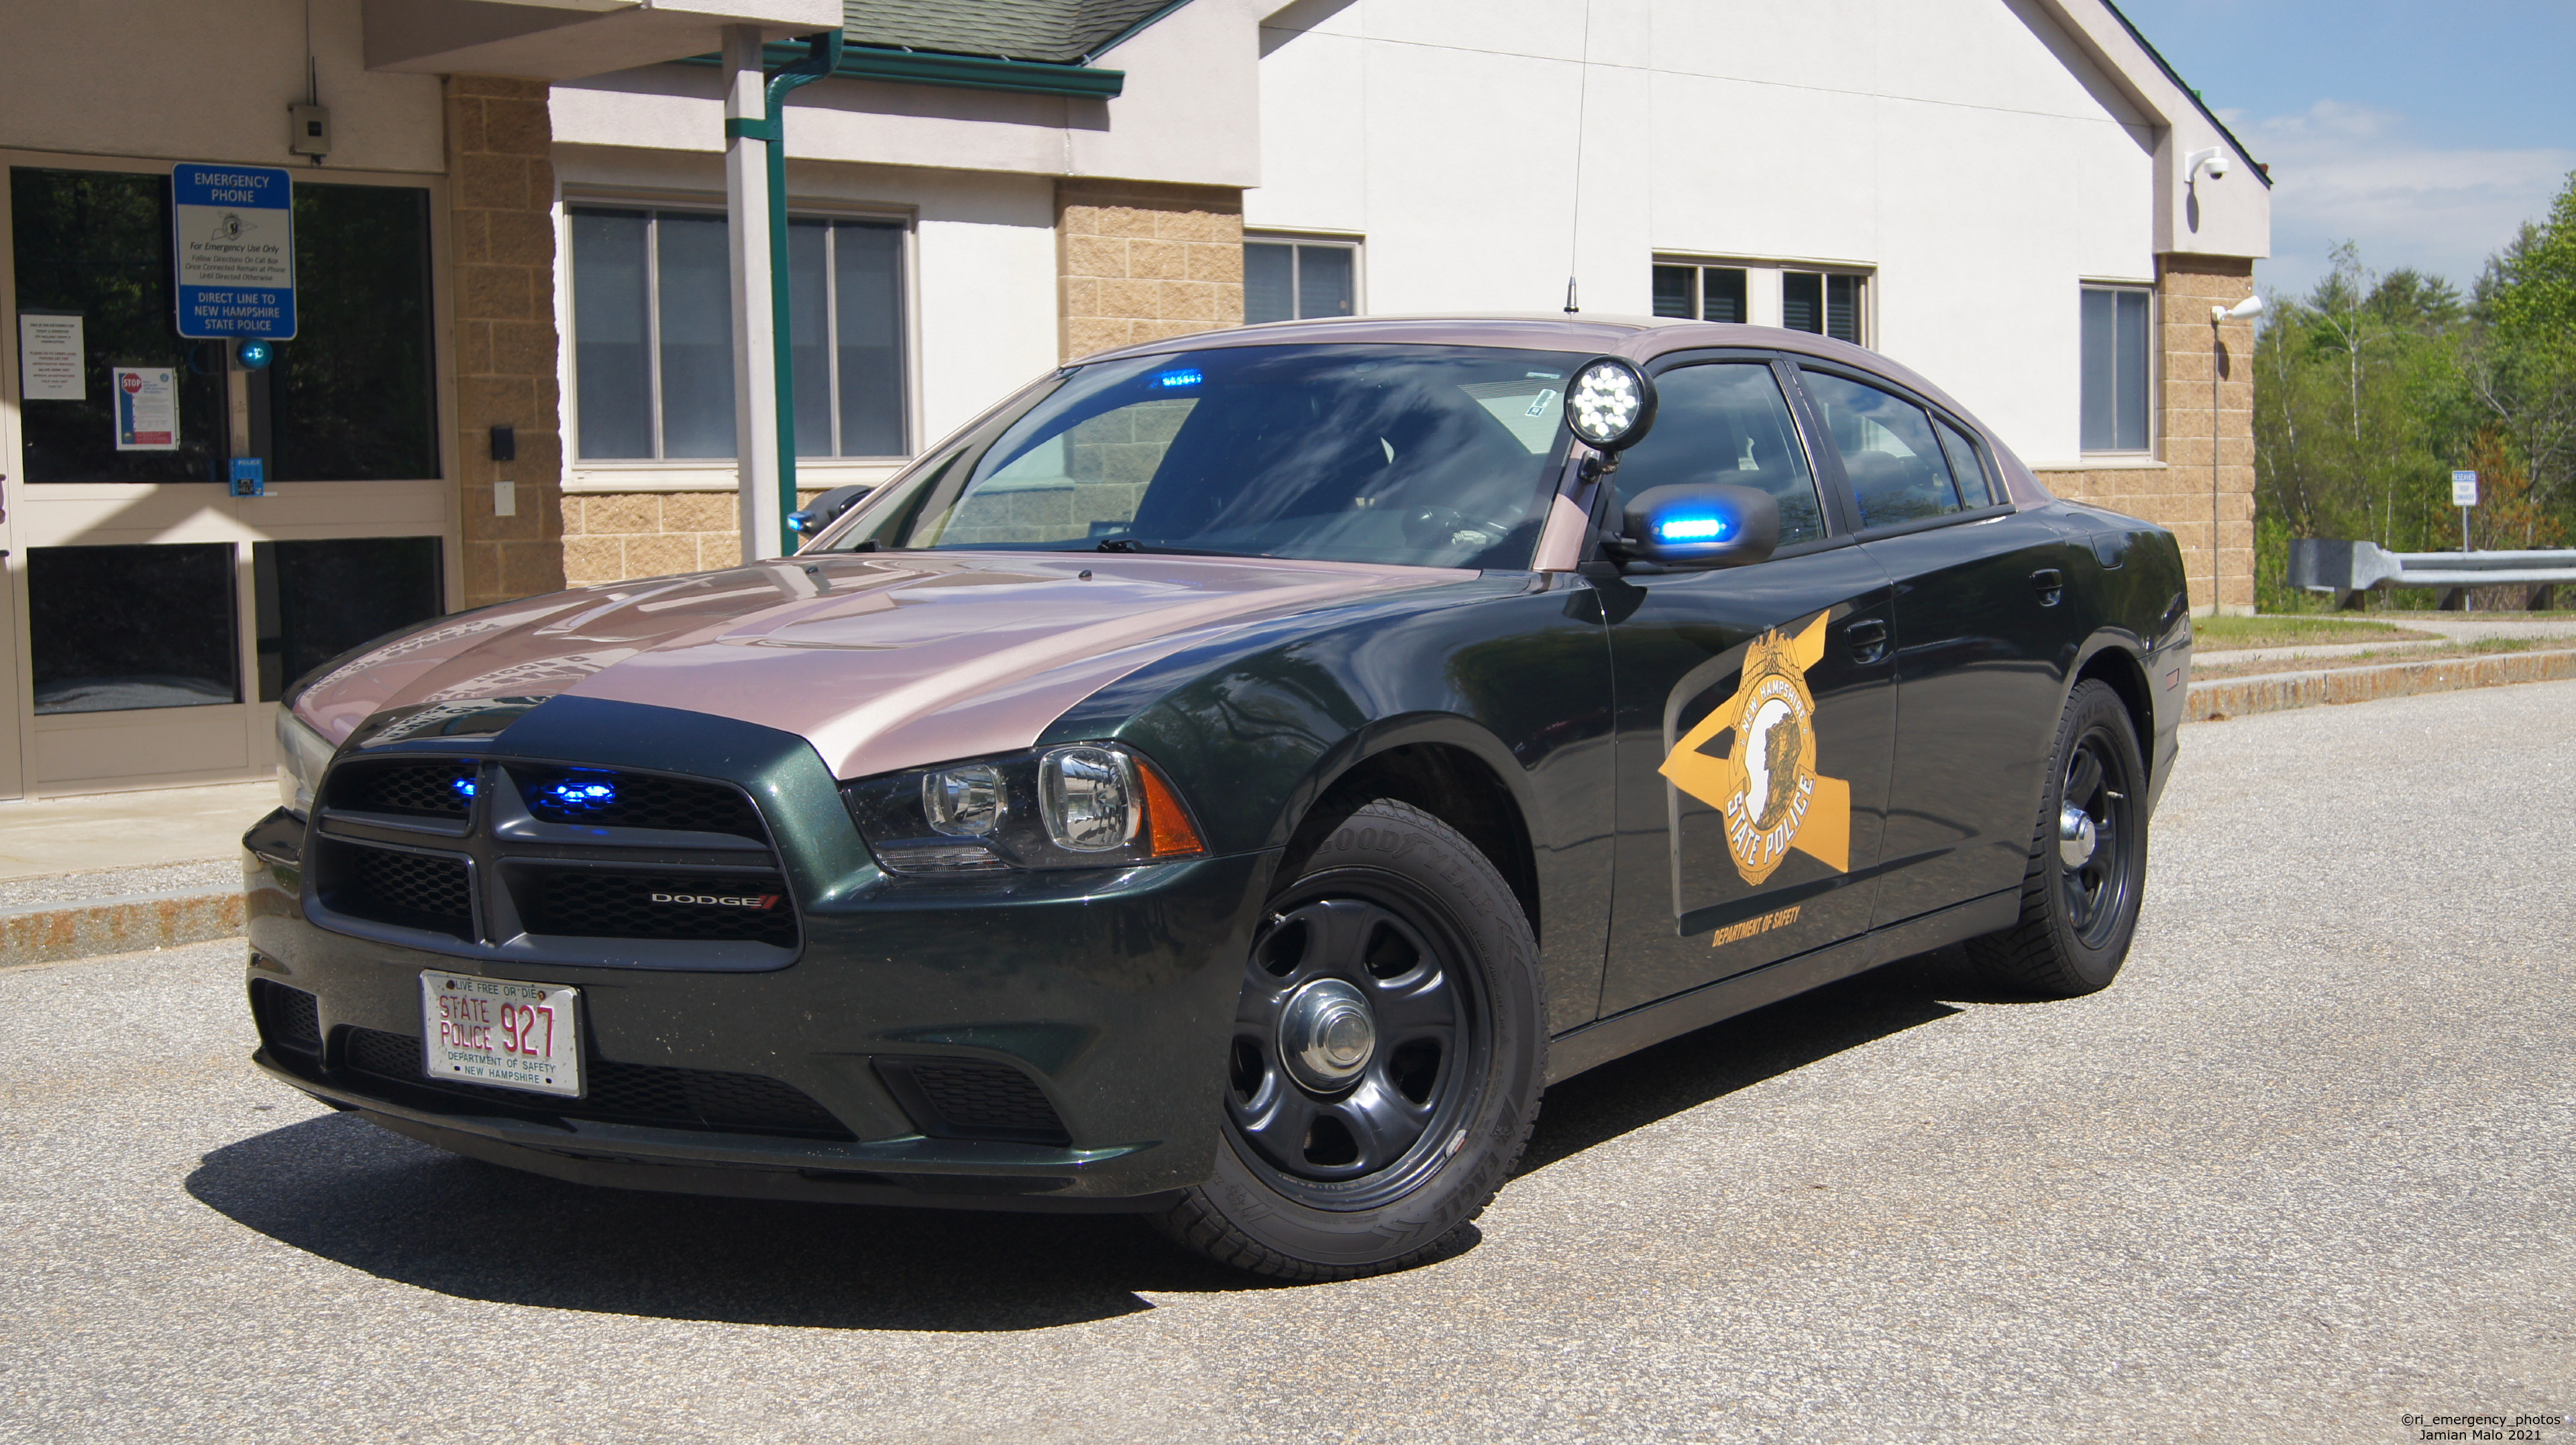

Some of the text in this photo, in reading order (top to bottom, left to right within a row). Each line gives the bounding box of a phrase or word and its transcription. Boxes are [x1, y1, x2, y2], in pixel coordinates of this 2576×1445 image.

[195, 172, 270, 188] EMERGENCY
[211, 189, 254, 202] PHONE
[191, 242, 279, 254] For Emergency Use Only
[199, 292, 276, 305] DIRECT LINE TO
[195, 306, 280, 318] NEW HAMPSHIRE
[205, 319, 272, 331] STATE POLICE
[2453, 473, 2475, 481] RESERVED
[1741, 680, 1805, 733] NEW HAMPSHIRE
[1727, 773, 1814, 866] STATE POLICE
[651, 893, 762, 906] DODGE
[1712, 905, 1801, 947] DEPARTMENT OF SAFETY
[455, 981, 537, 998] LIVE FREE OR DIE
[440, 995, 490, 1023] STATE
[441, 1020, 493, 1051] POLICE
[500, 1003, 553, 1057] 927
[448, 1051, 556, 1073] DEPARTMENT OF SAFETY
[464, 1065, 540, 1083] NEW HAMPSHIRE
